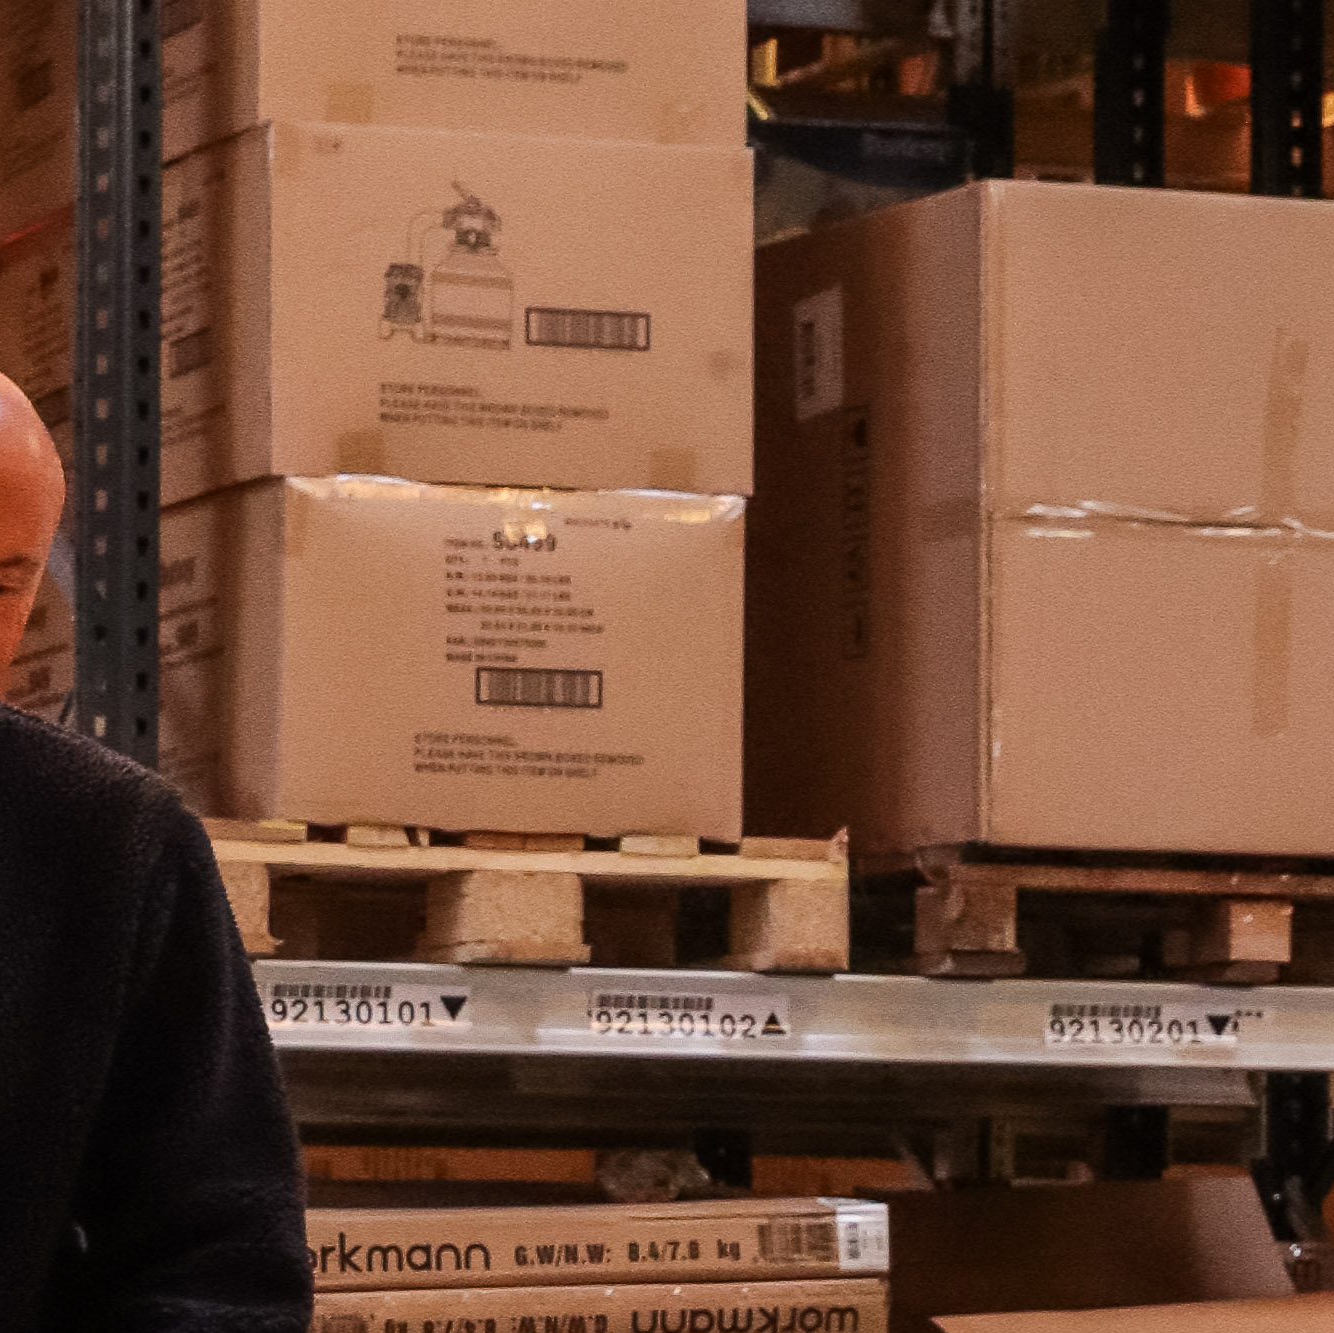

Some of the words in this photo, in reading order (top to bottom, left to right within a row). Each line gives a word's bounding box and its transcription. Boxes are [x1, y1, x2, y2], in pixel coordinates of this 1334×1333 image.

[271, 1000, 435, 1025] 92130101
[595, 1009, 756, 1038] 92130102
[1049, 1020, 1201, 1044] 92130201
[307, 1232, 490, 1274] rkmann
[717, 1241, 740, 1263] kg
